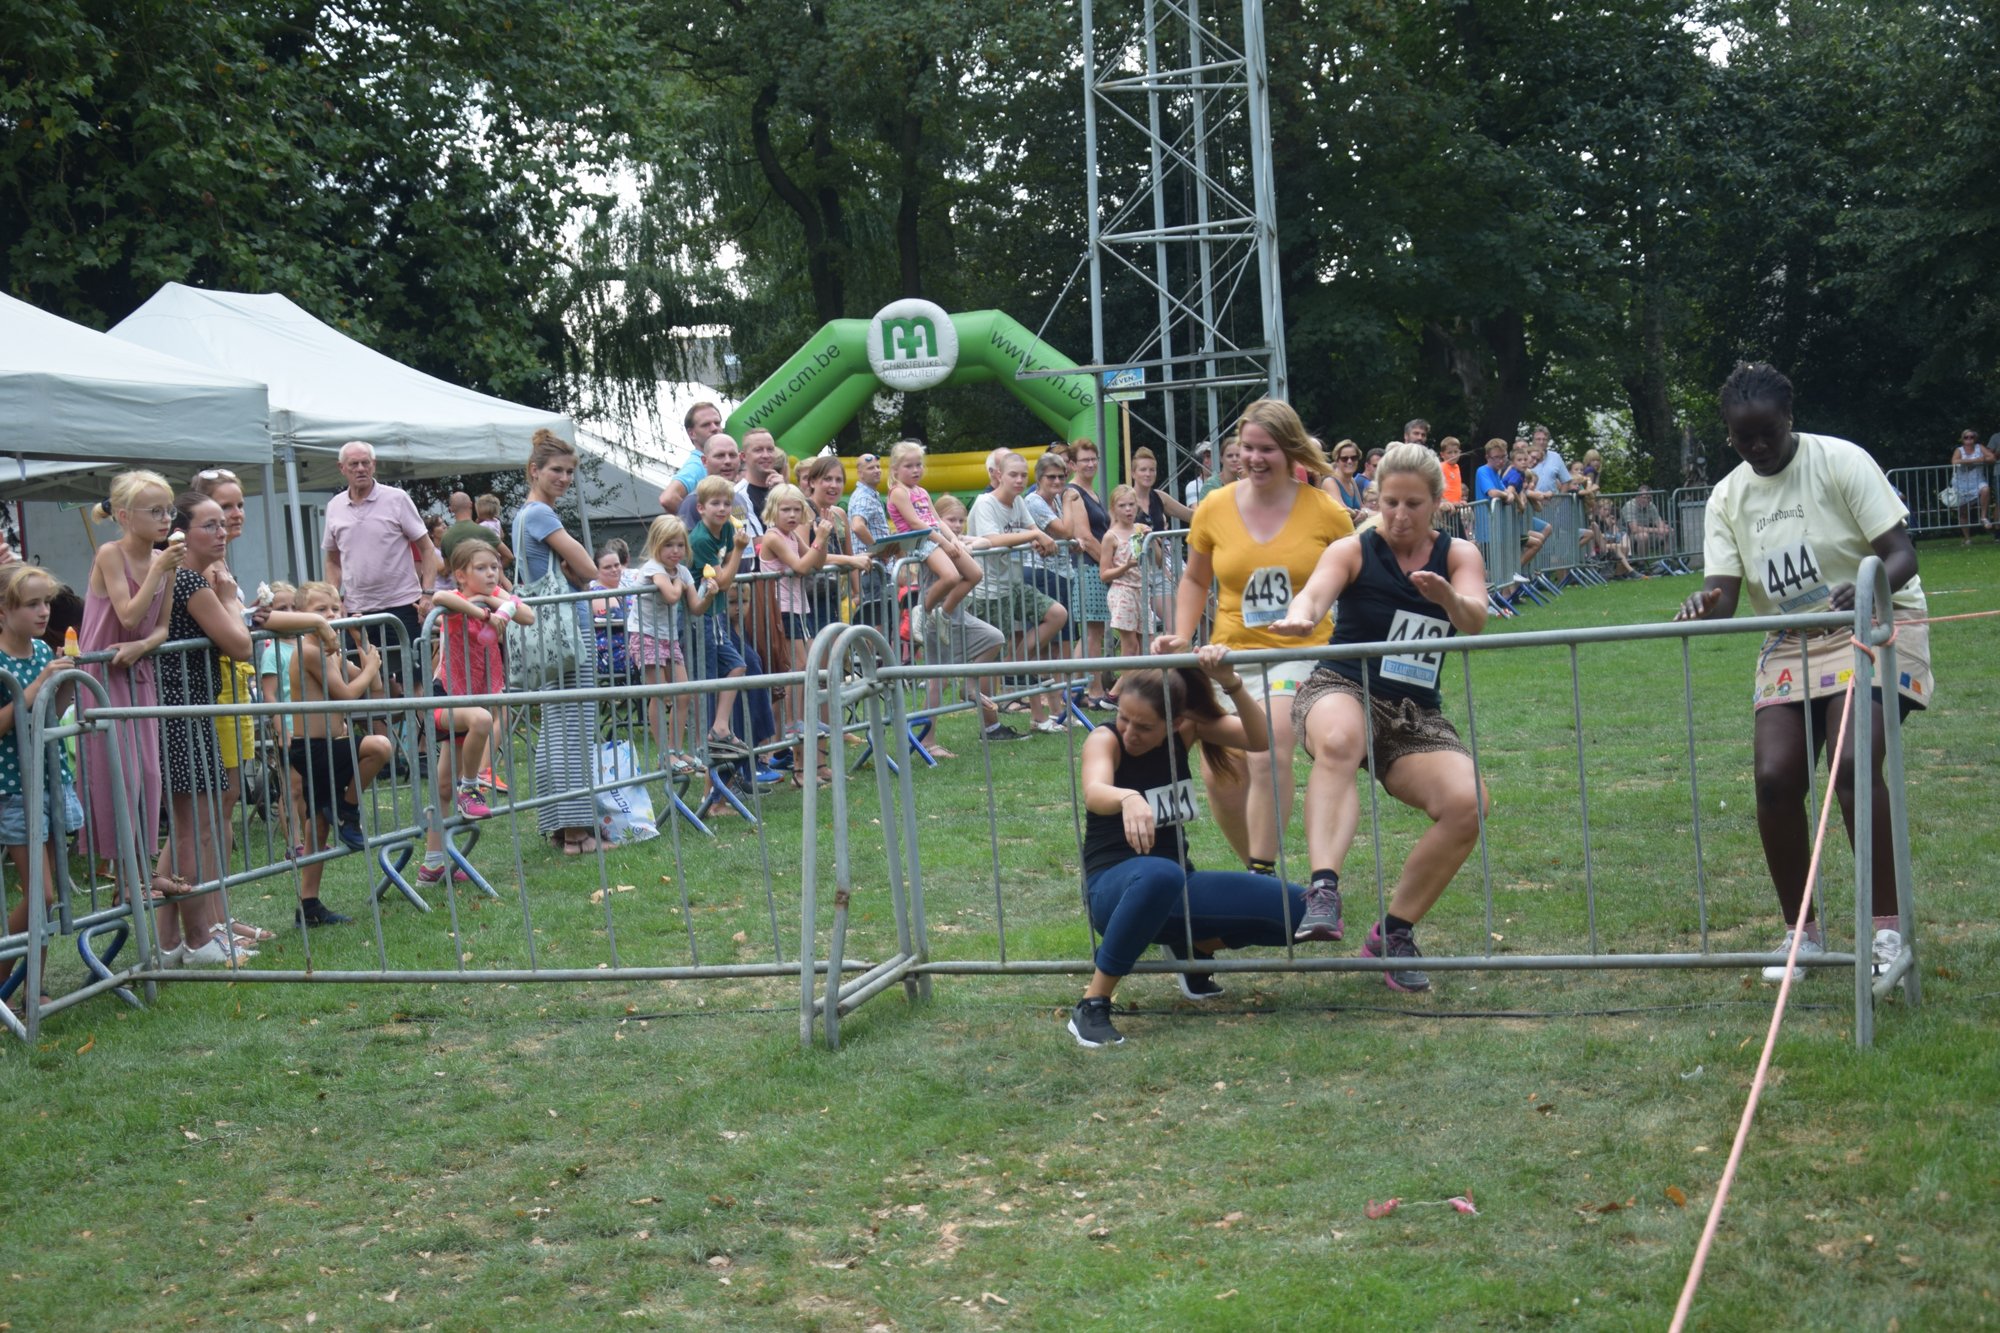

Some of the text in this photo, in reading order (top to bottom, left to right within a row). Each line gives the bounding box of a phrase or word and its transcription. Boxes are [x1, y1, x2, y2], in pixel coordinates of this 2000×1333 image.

[744, 345, 840, 428] www.cm.be
[882, 369, 937, 380] MUTUALITEIT
[1245, 572, 1290, 607] 443
[1768, 544, 1819, 598] 444
[610, 787, 631, 813] ACTIO
[1156, 785, 1195, 827] 441
